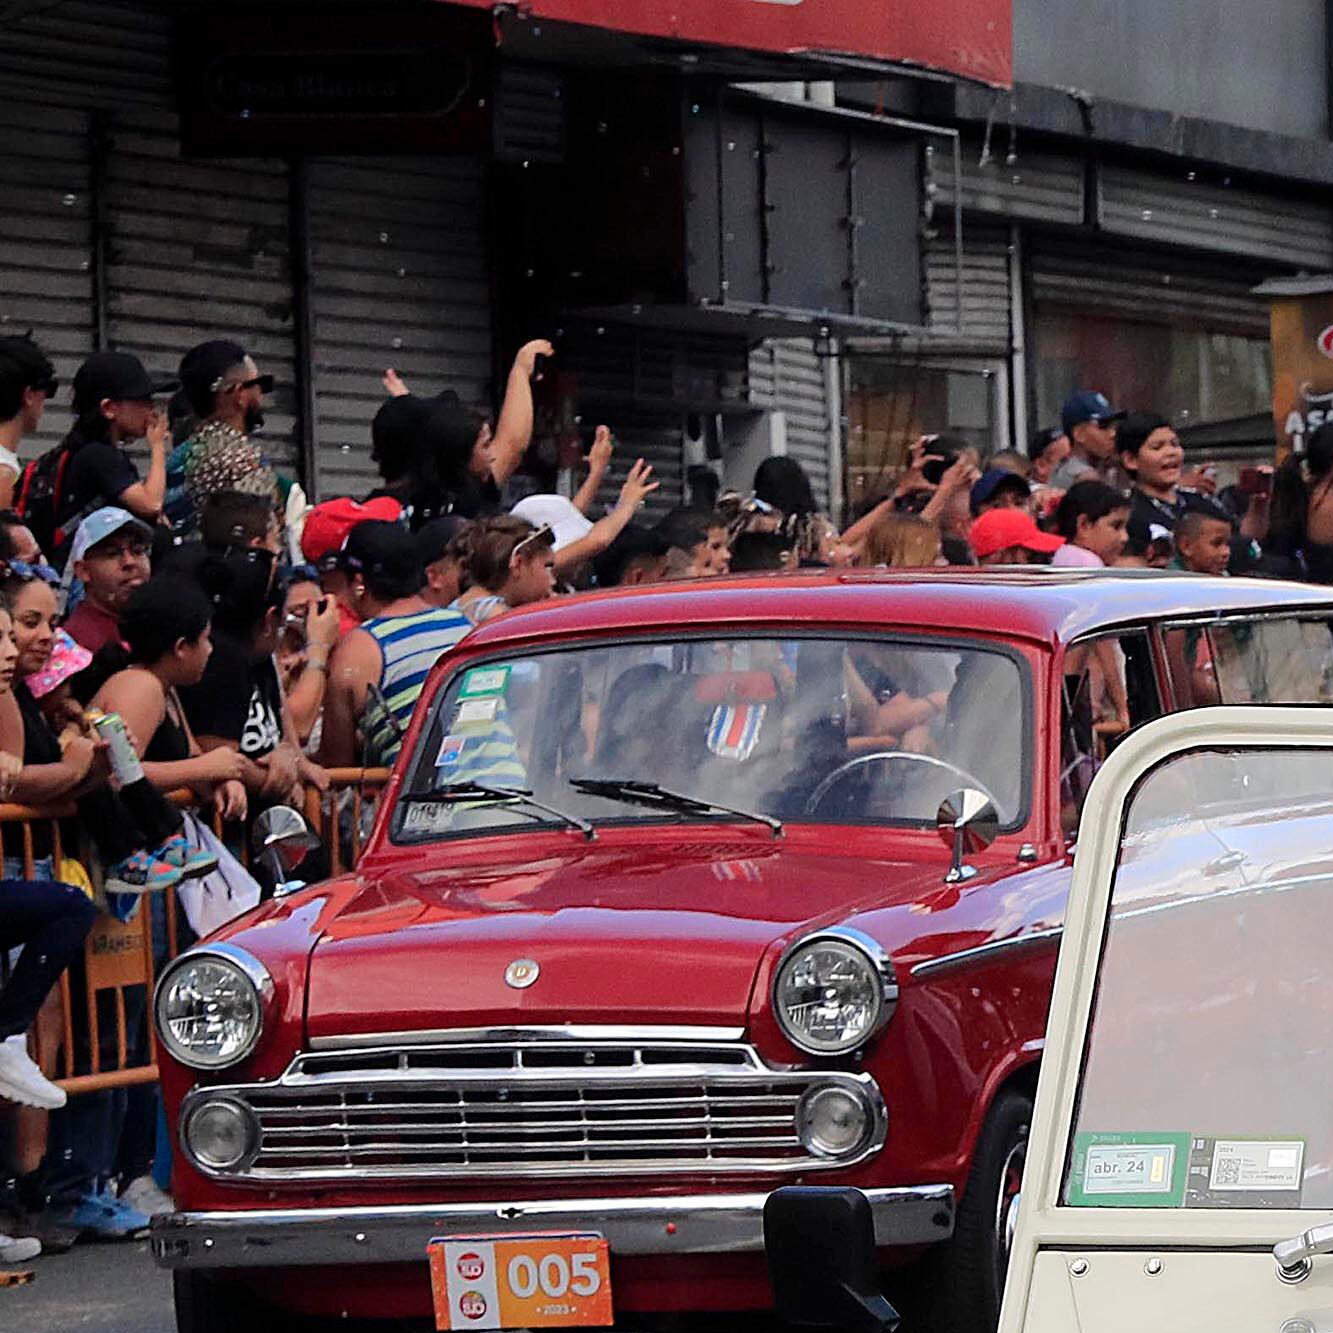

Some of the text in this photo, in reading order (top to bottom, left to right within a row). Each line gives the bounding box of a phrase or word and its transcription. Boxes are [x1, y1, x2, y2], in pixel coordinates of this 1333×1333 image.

[1093, 1161, 1122, 1174] abr.
[1126, 1160, 1145, 1173] 24
[507, 1252, 601, 1299] 005
